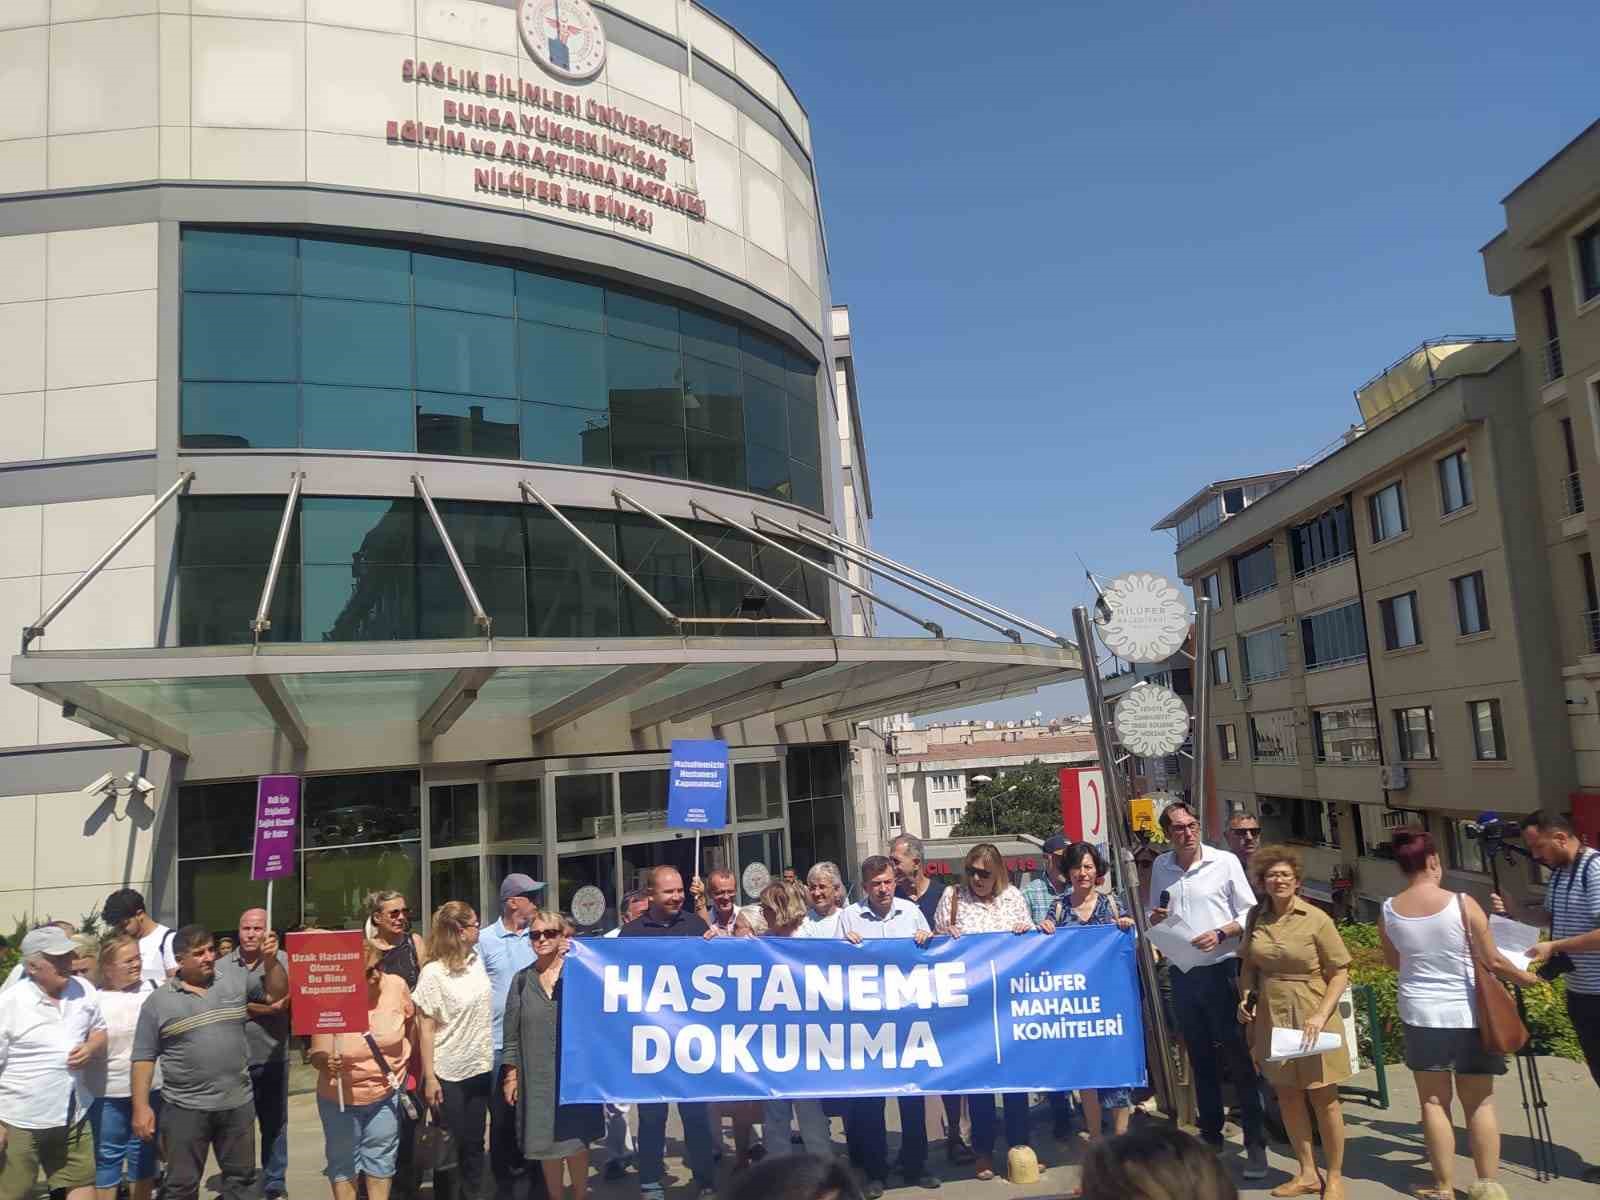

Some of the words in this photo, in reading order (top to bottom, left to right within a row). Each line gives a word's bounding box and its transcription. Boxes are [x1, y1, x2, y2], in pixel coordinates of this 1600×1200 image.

[402, 59, 480, 93] SAĞLIK
[485, 73, 582, 115] BİLİMLERİ
[444, 99, 517, 133] BURSA
[520, 114, 599, 152] YÜKSEK
[386, 119, 466, 151] EĞİTİM
[501, 139, 618, 186] ARAŞTIRMA
[474, 167, 563, 202] NİLÜFER
[566, 187, 591, 210] EK
[594, 194, 654, 227] BİNASI
[308, 974, 322, 984] Bu
[603, 962, 969, 1013] HASTANEME
[1010, 971, 1087, 993] NİLÜFER
[1010, 996, 1102, 1017] MAHALLE
[1013, 1013, 1124, 1041] KOMİTELERİ
[631, 1021, 944, 1074] DOKUNMA
